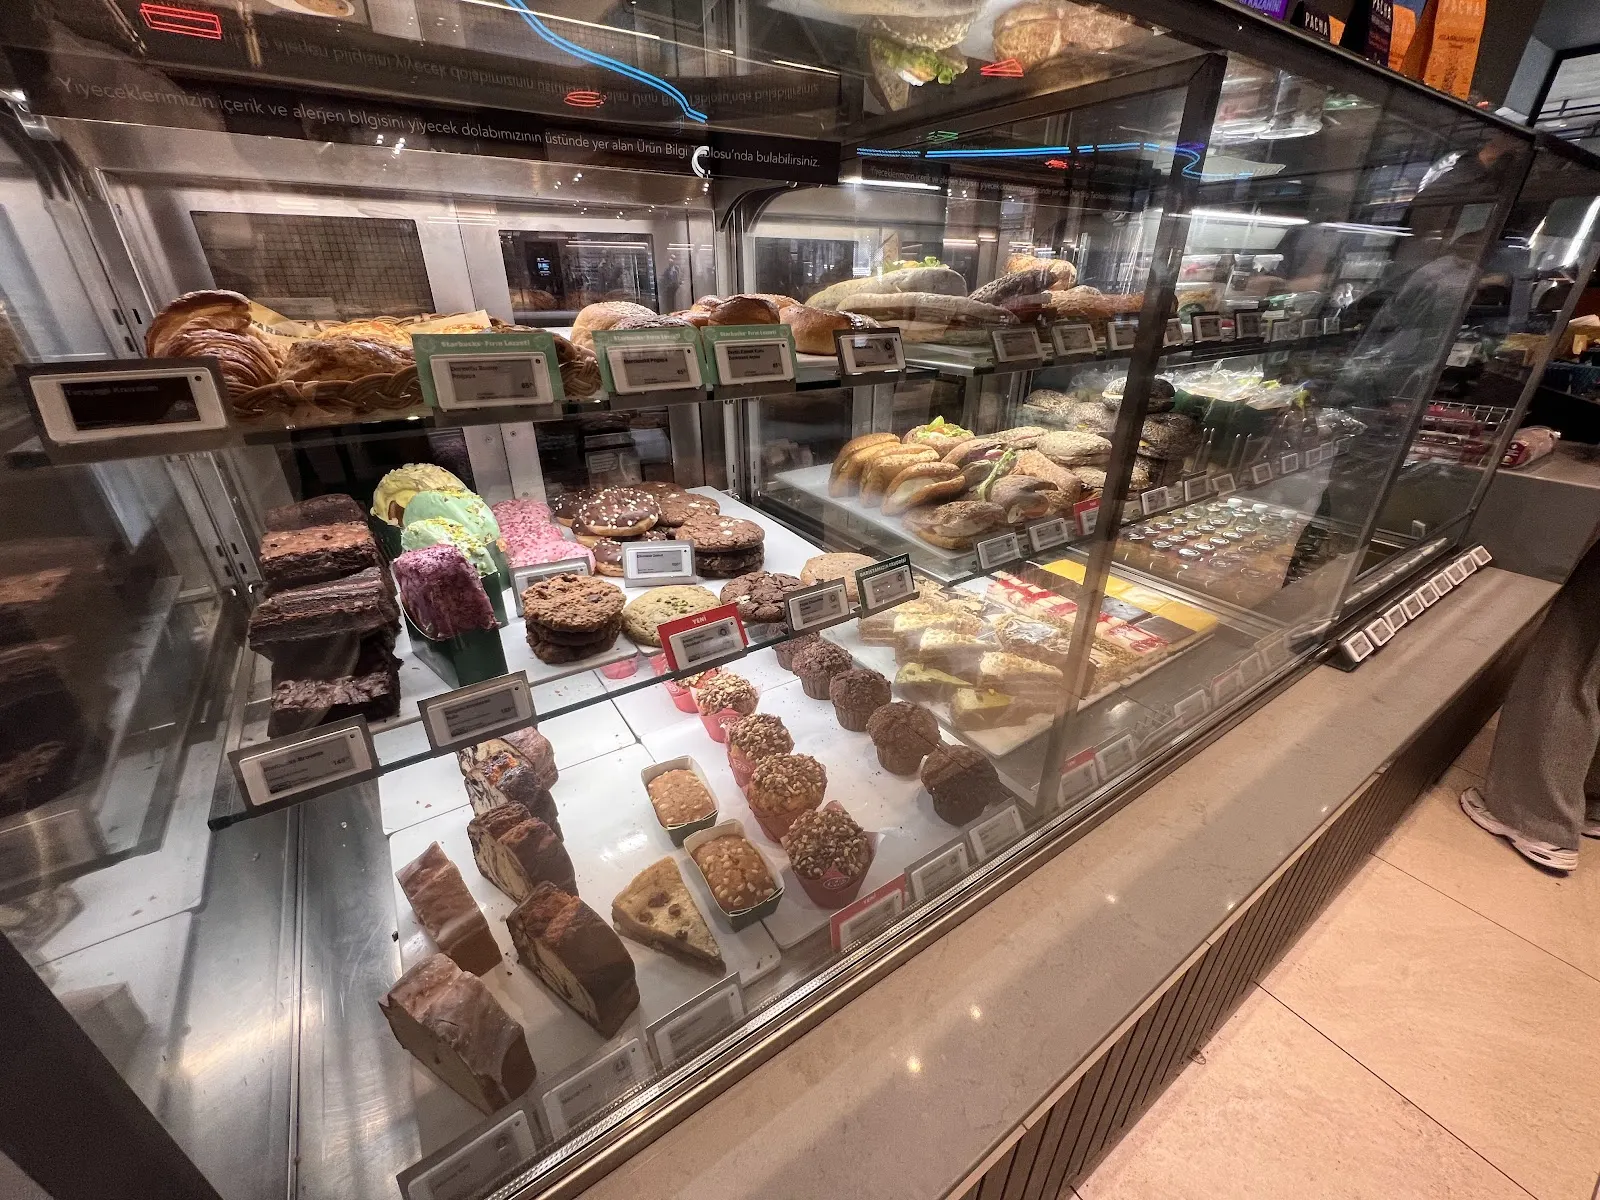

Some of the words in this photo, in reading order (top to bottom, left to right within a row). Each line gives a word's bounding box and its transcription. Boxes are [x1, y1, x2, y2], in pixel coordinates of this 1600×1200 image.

[57, 77, 213, 108] Yiyeceklerimizin
[218, 95, 265, 115] içerik
[269, 104, 288, 116] ve
[293, 103, 345, 124] alerjen
[348, 109, 405, 130] bilgisini
[408, 116, 458, 135] yiyecek
[461, 122, 542, 143] dolabımızının
[545, 130, 589, 148] üstünde
[591, 140, 609, 152] yer
[612, 139, 634, 153] alan
[637, 138, 662, 154] Ürün
[665, 143, 689, 159] Bilgi
[756, 149, 820, 167] bulabilirsiniz.
[692, 615, 707, 625] YENİ
